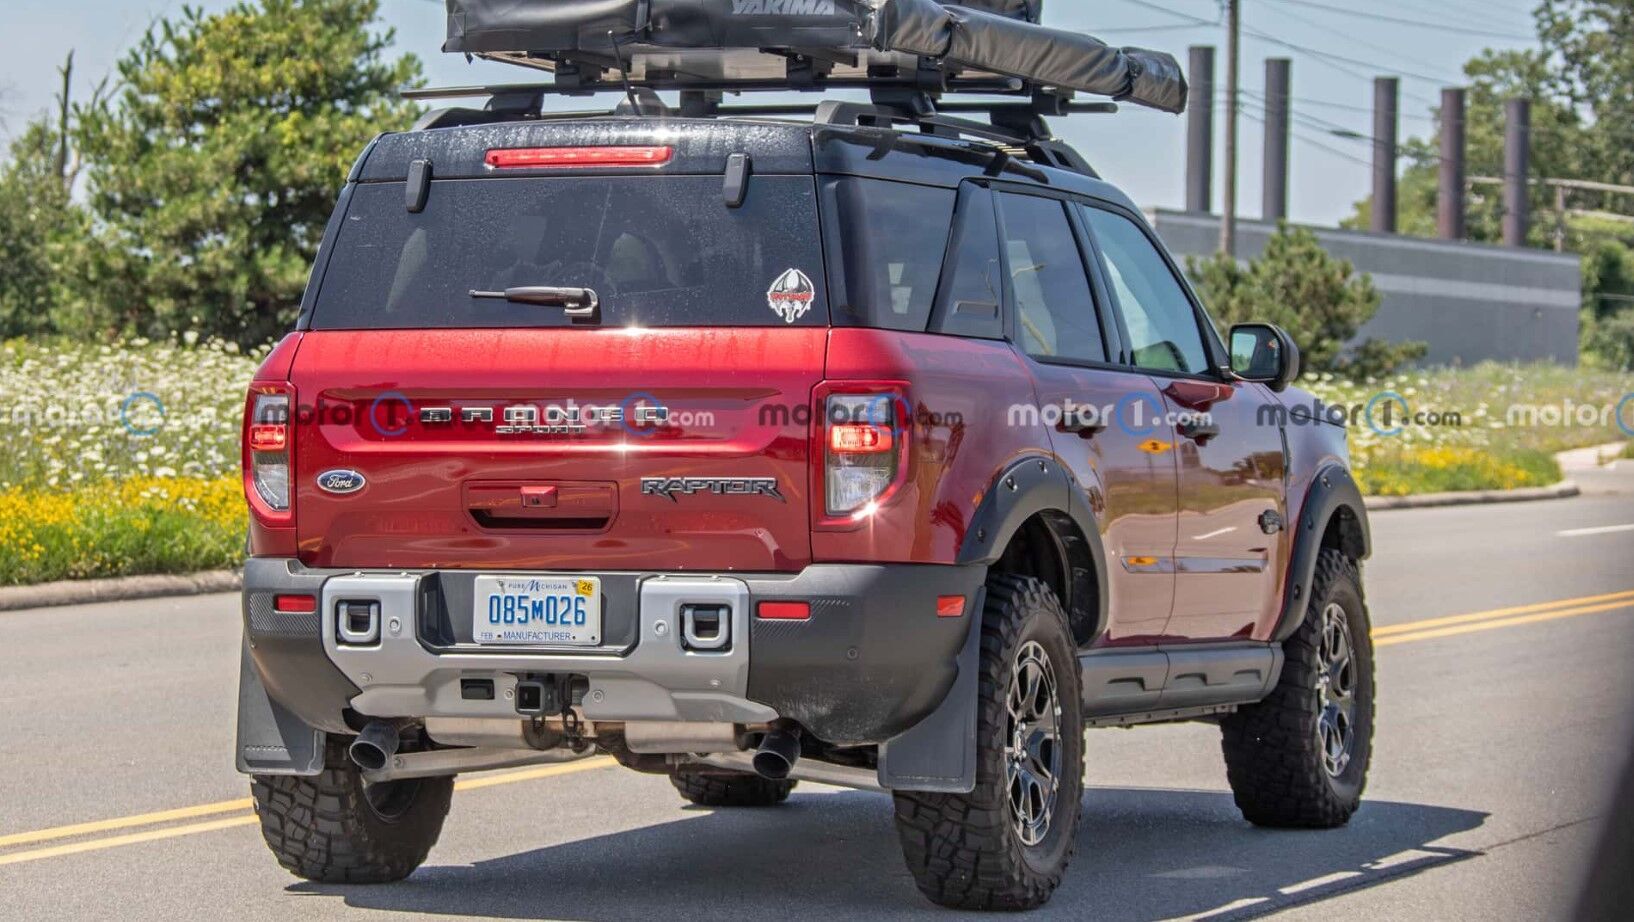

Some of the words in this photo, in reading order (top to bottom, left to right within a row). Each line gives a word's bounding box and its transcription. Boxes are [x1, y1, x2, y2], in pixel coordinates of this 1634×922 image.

[732, 0, 835, 15] YAKIMA
[420, 406, 669, 422] BRONCO
[495, 425, 586, 434] SPORT
[327, 474, 354, 488] Ford
[640, 476, 787, 504] RAPTOR
[581, 582, 593, 592] 26
[488, 595, 586, 625] 085M026
[503, 631, 571, 641] MANUFACTURER
